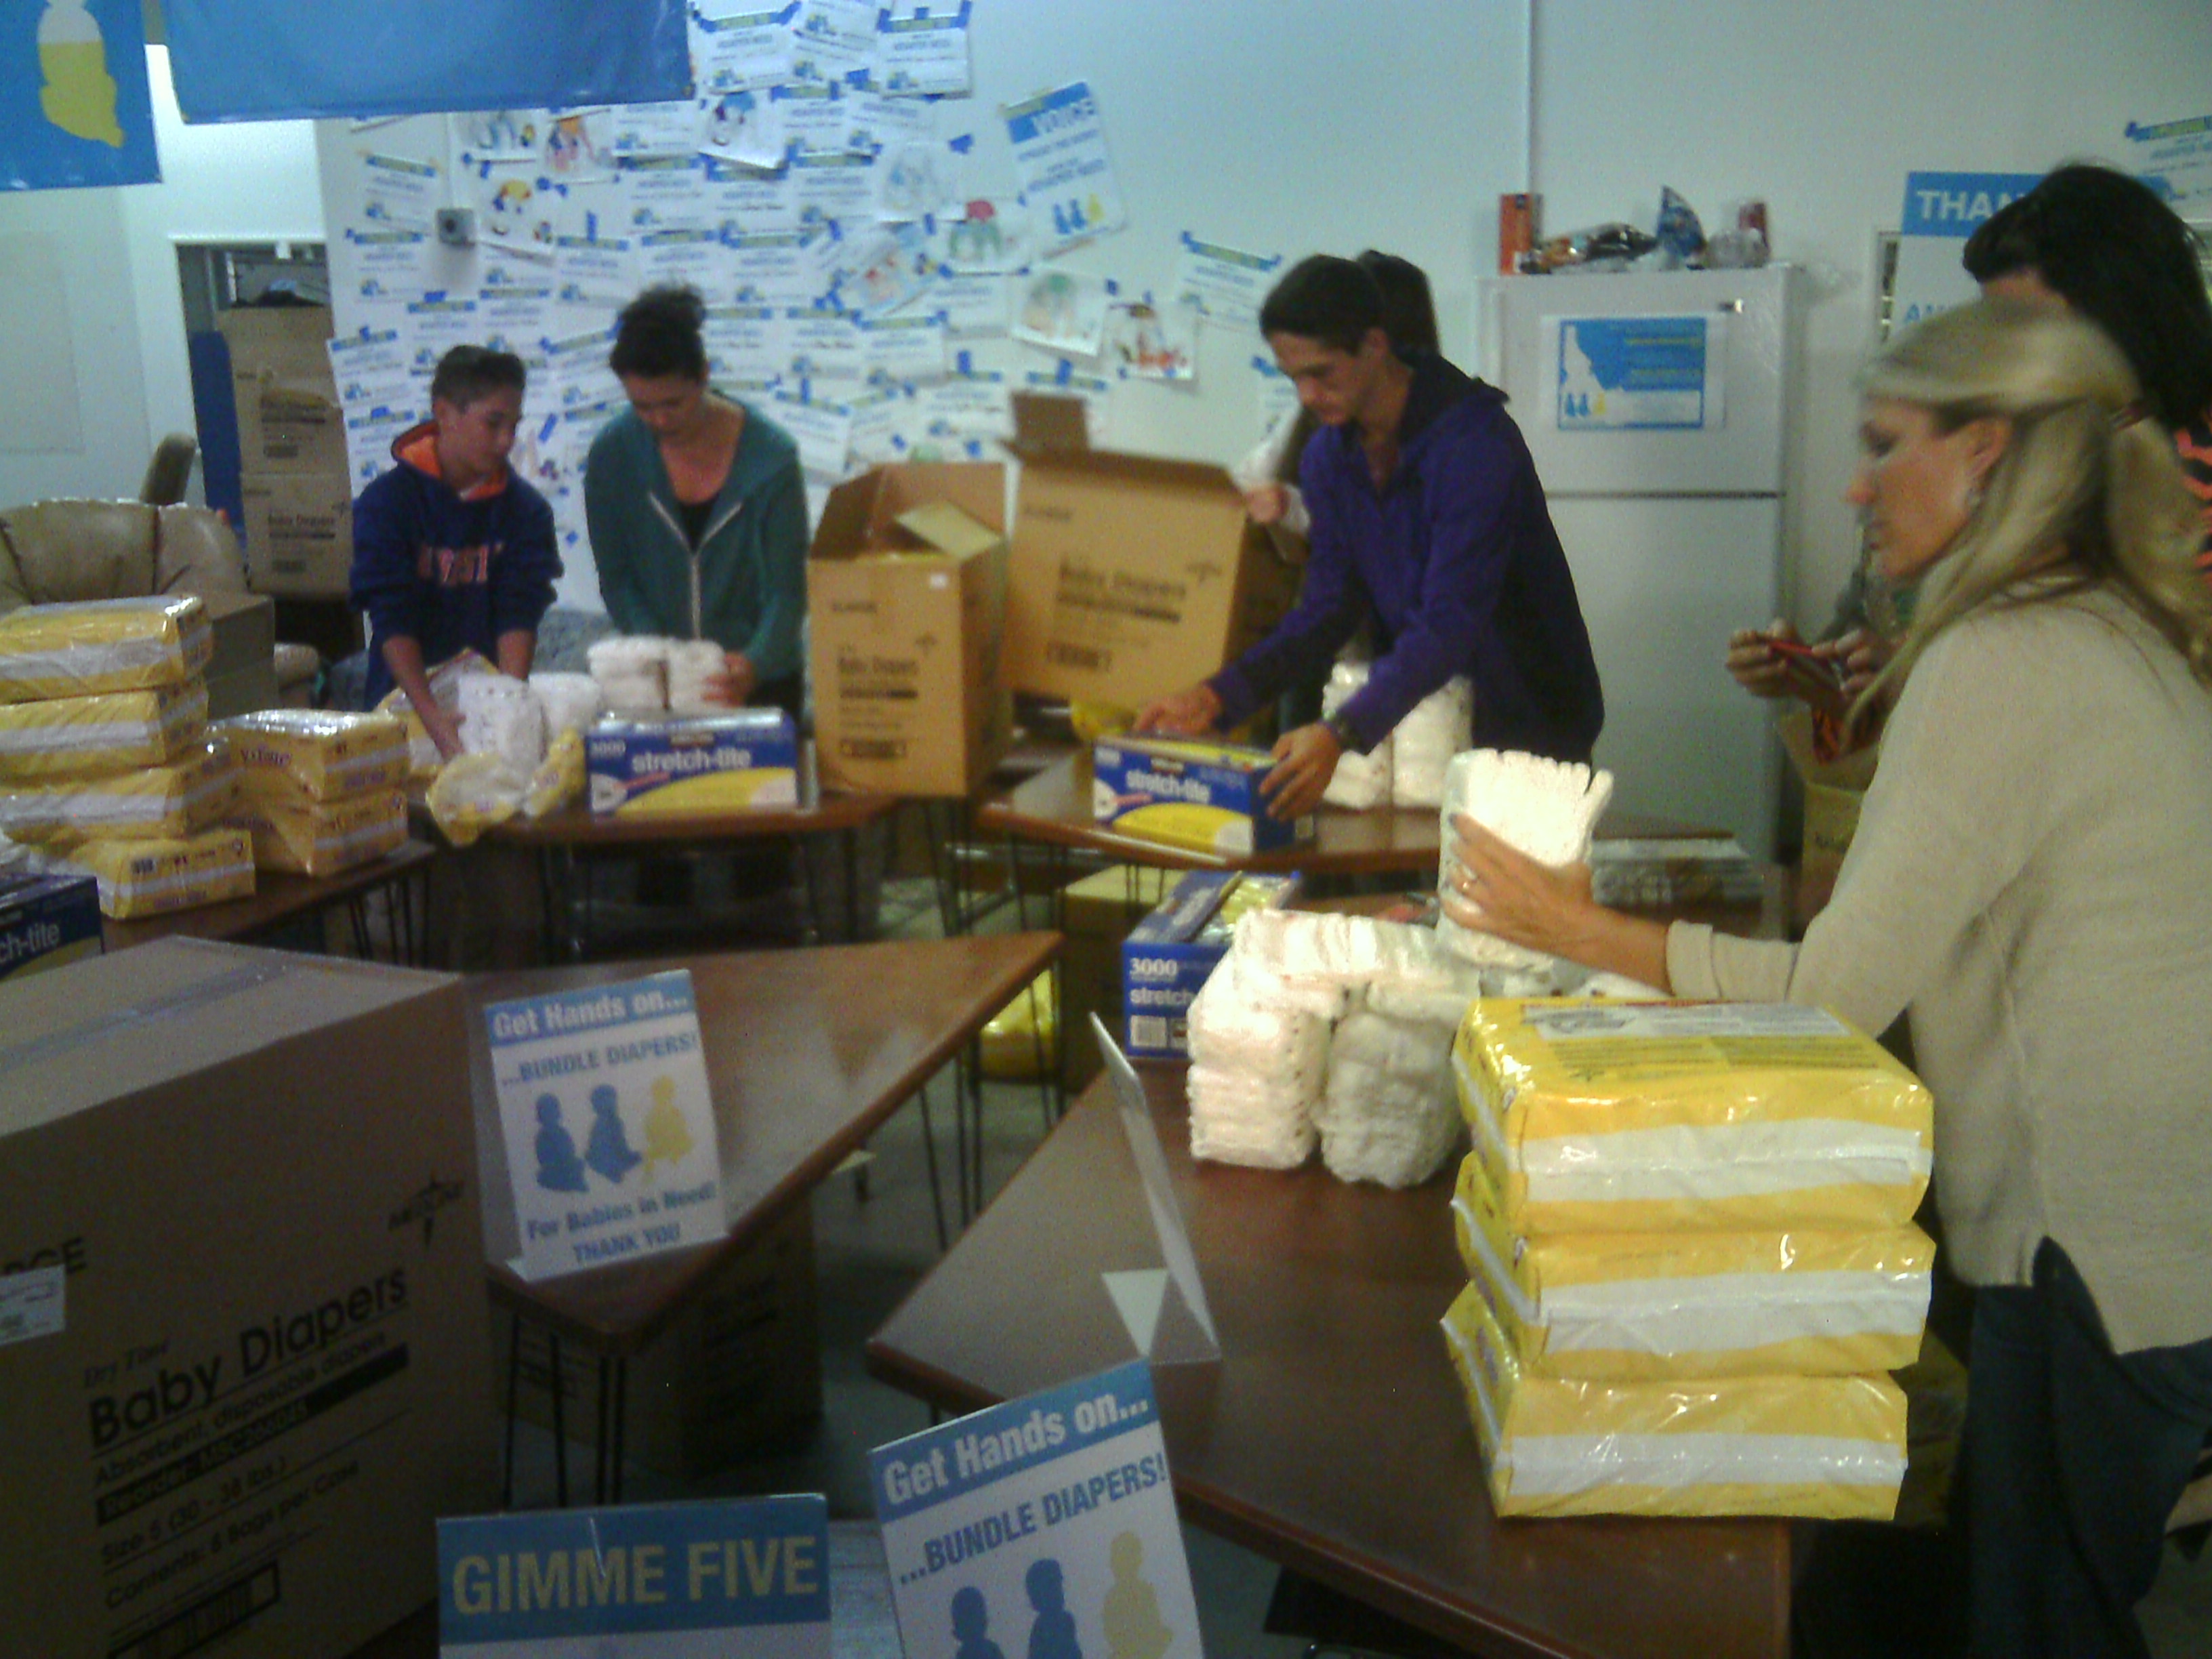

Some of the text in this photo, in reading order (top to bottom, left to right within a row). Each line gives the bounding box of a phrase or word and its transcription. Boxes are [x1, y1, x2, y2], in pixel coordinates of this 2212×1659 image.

[1129, 957, 1178, 976] 3000
[493, 1008, 540, 1038] Get
[544, 996, 626, 1030] Hands
[573, 1232, 640, 1264] THANK
[89, 1268, 407, 1449] Baby Diapers
[883, 1393, 1149, 1506] Get Hands on...
[227, 1507, 273, 1544] Bags
[278, 1487, 310, 1520] per
[900, 1452, 1170, 1585] ...BUNDLE DIAPERS!
[102, 1532, 144, 1565] Size
[452, 1535, 818, 1616] GIMME FIVE
